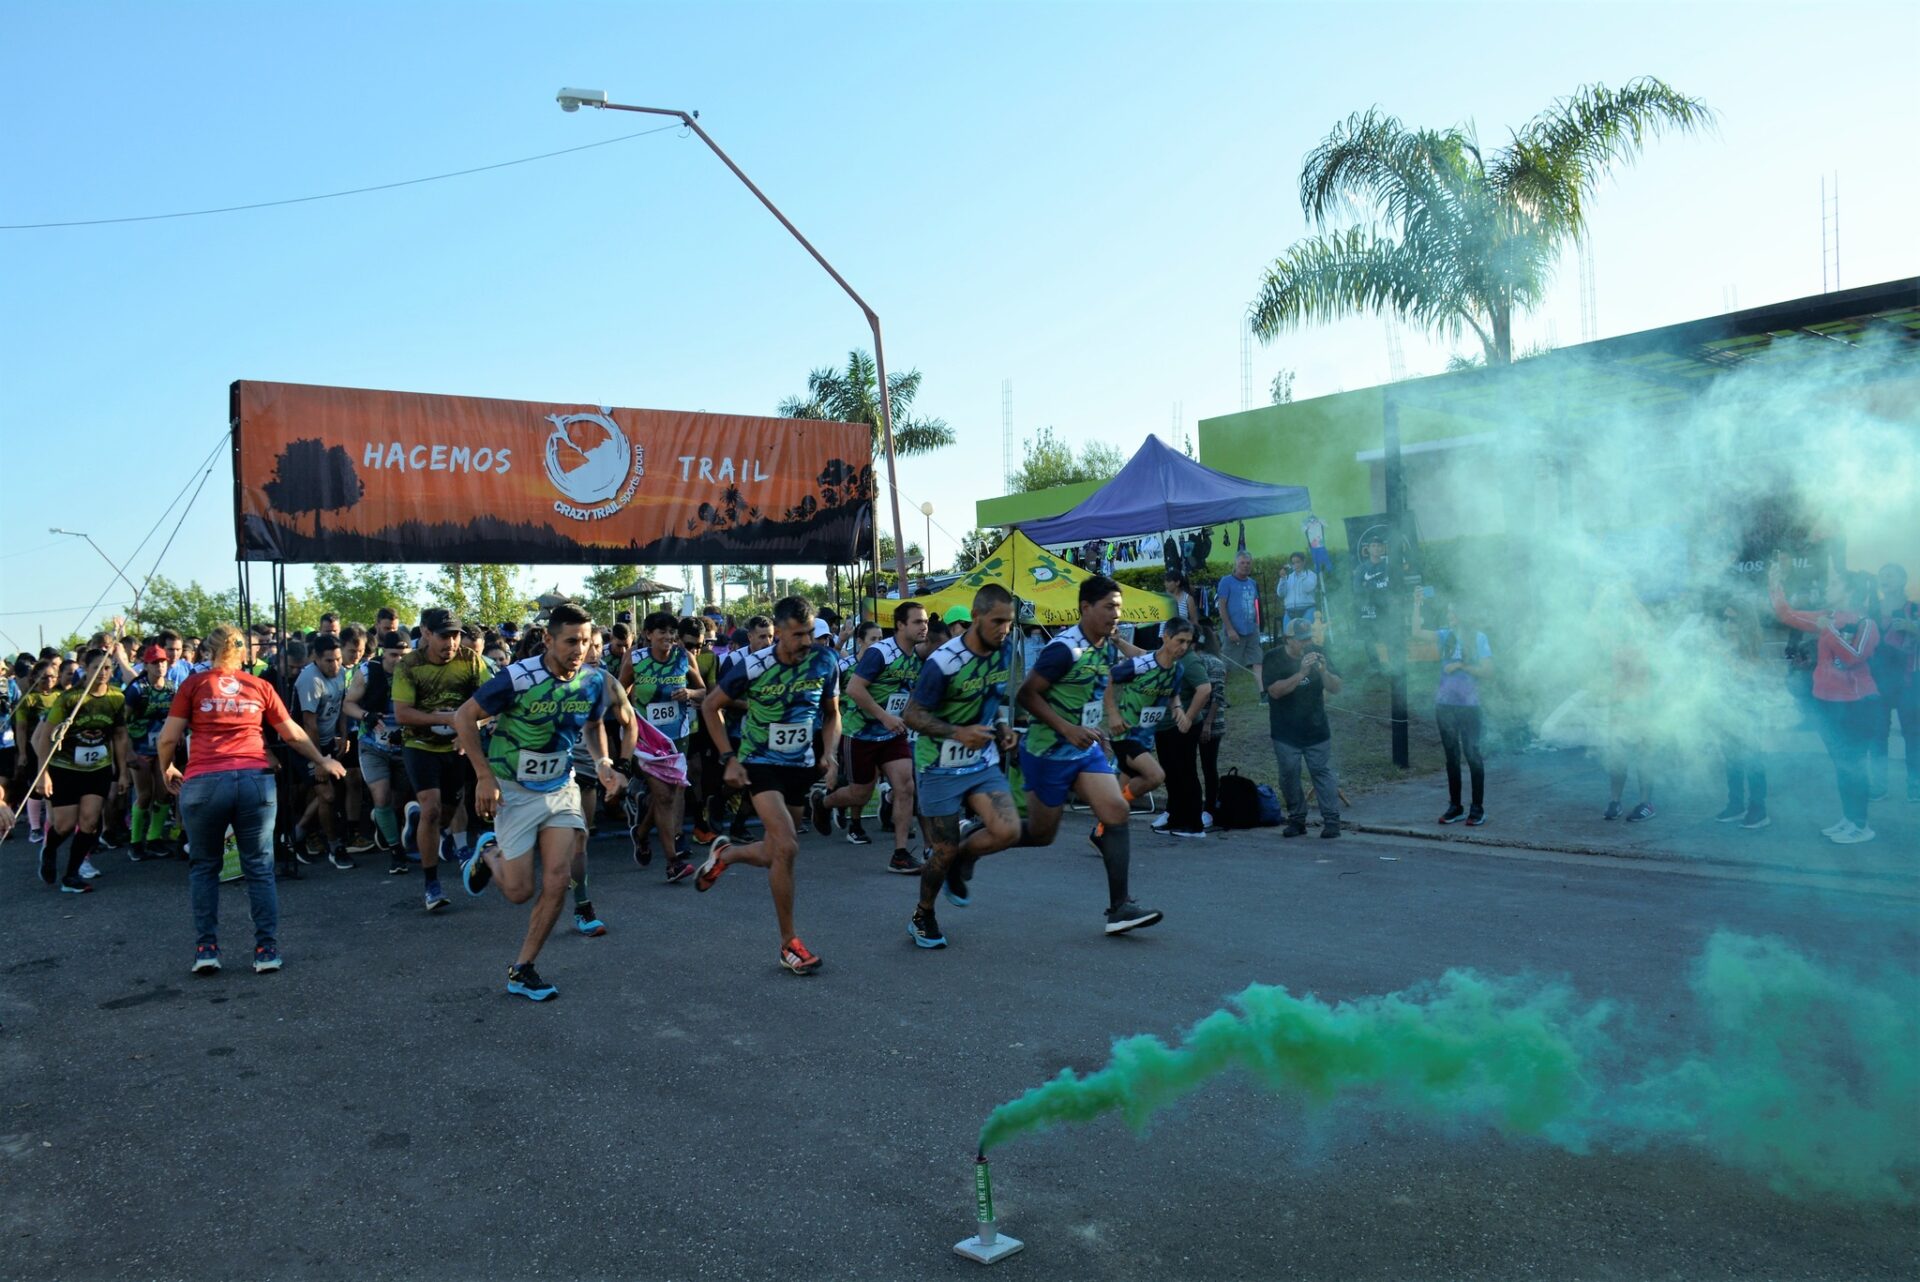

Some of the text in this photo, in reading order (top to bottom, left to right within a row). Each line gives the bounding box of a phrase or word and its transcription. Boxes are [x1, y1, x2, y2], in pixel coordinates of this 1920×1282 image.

[363, 442, 770, 484] HACEMOS TRAIL
[553, 444, 644, 520] CRAZY TRAIL sports group
[200, 698, 261, 713] STAFF
[530, 701, 557, 713] ORO
[890, 698, 905, 711] 156
[652, 706, 675, 720] 268
[1142, 711, 1161, 723] 362
[775, 728, 808, 745] 373
[84, 751, 100, 762] 12
[525, 758, 559, 775] 217
